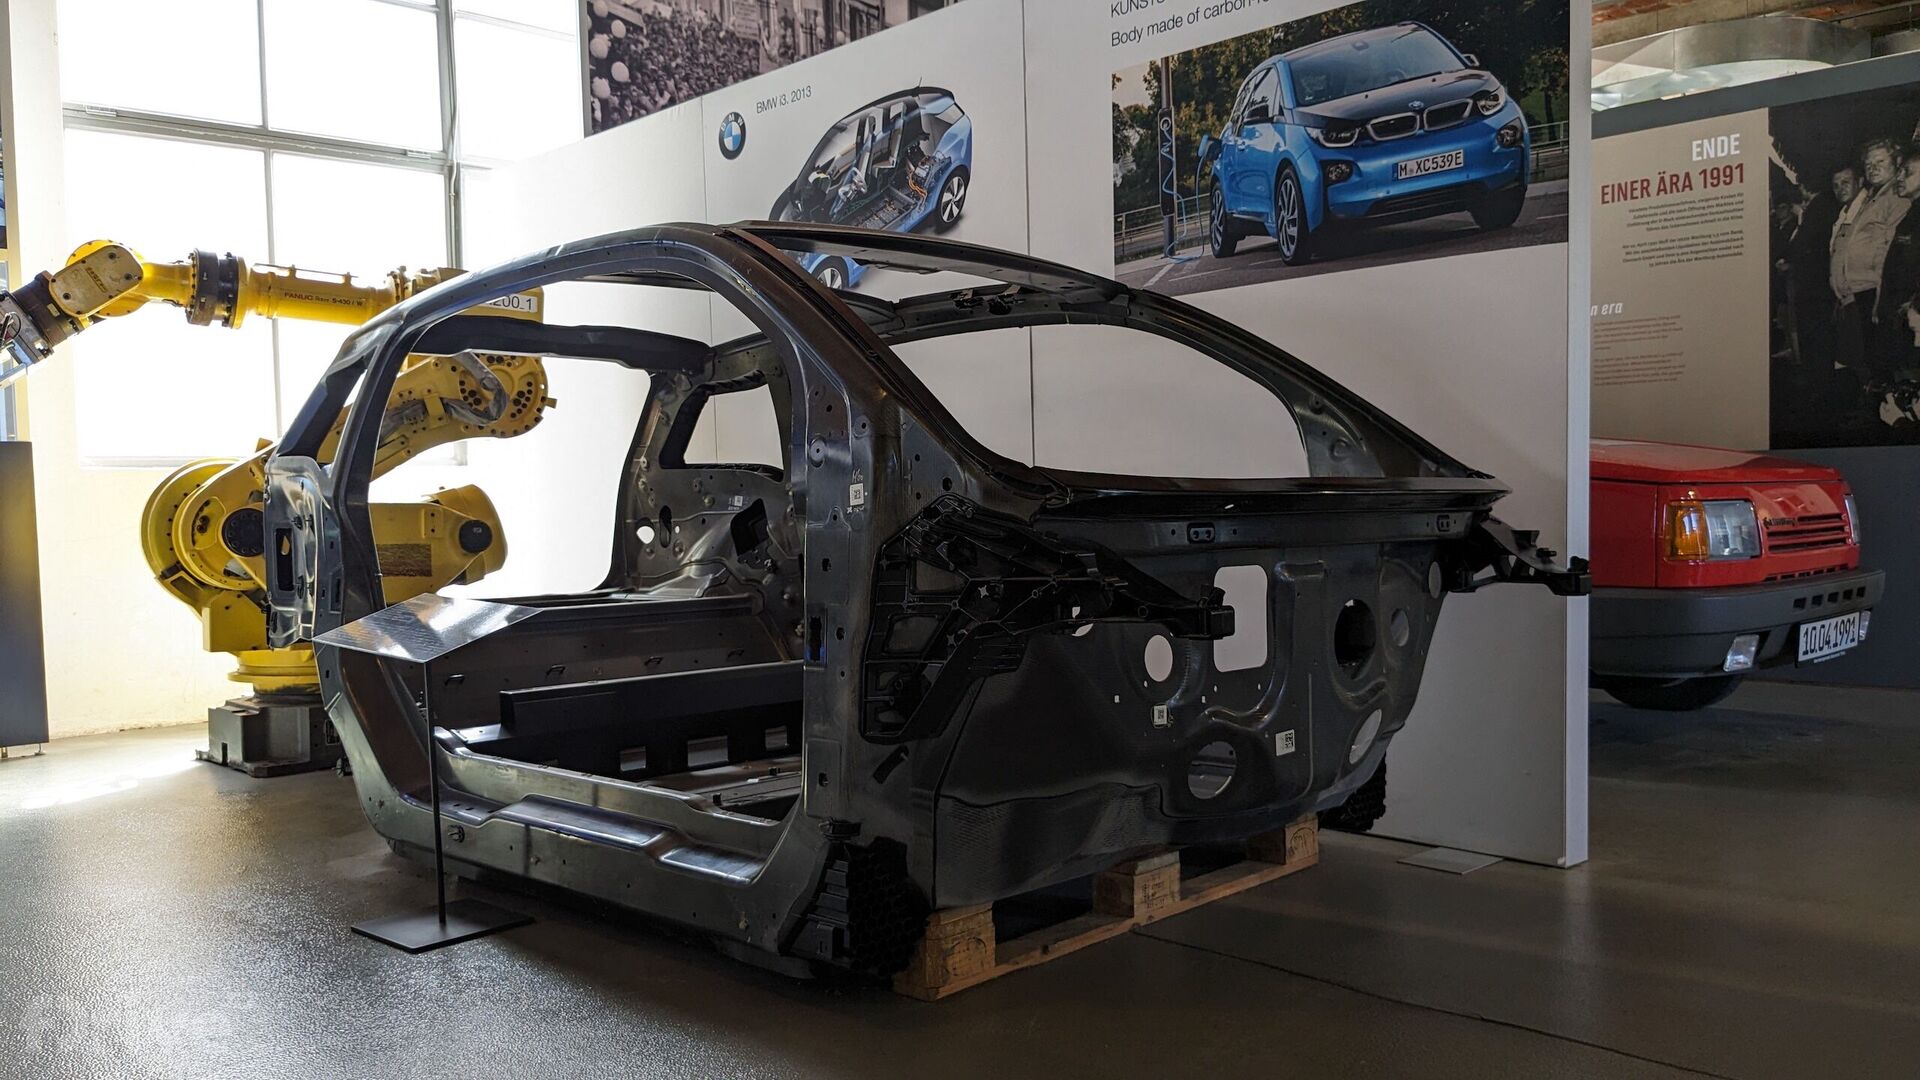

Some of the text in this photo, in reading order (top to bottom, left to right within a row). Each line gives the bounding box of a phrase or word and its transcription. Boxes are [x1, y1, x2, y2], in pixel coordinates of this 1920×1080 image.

[1111, 0, 1165, 18] KUNS
[1111, 0, 1251, 47] Body made of carbon
[756, 96, 777, 114] BMW
[791, 85, 812, 103] 2013
[1692, 133, 1741, 162] ENDE
[1400, 152, 1462, 177] M XC539E
[1600, 162, 1745, 205] EINER ÄRA 1991
[284, 292, 313, 301] FANUC
[1601, 302, 1623, 315] era
[1802, 616, 1856, 656] 10.04.1991
